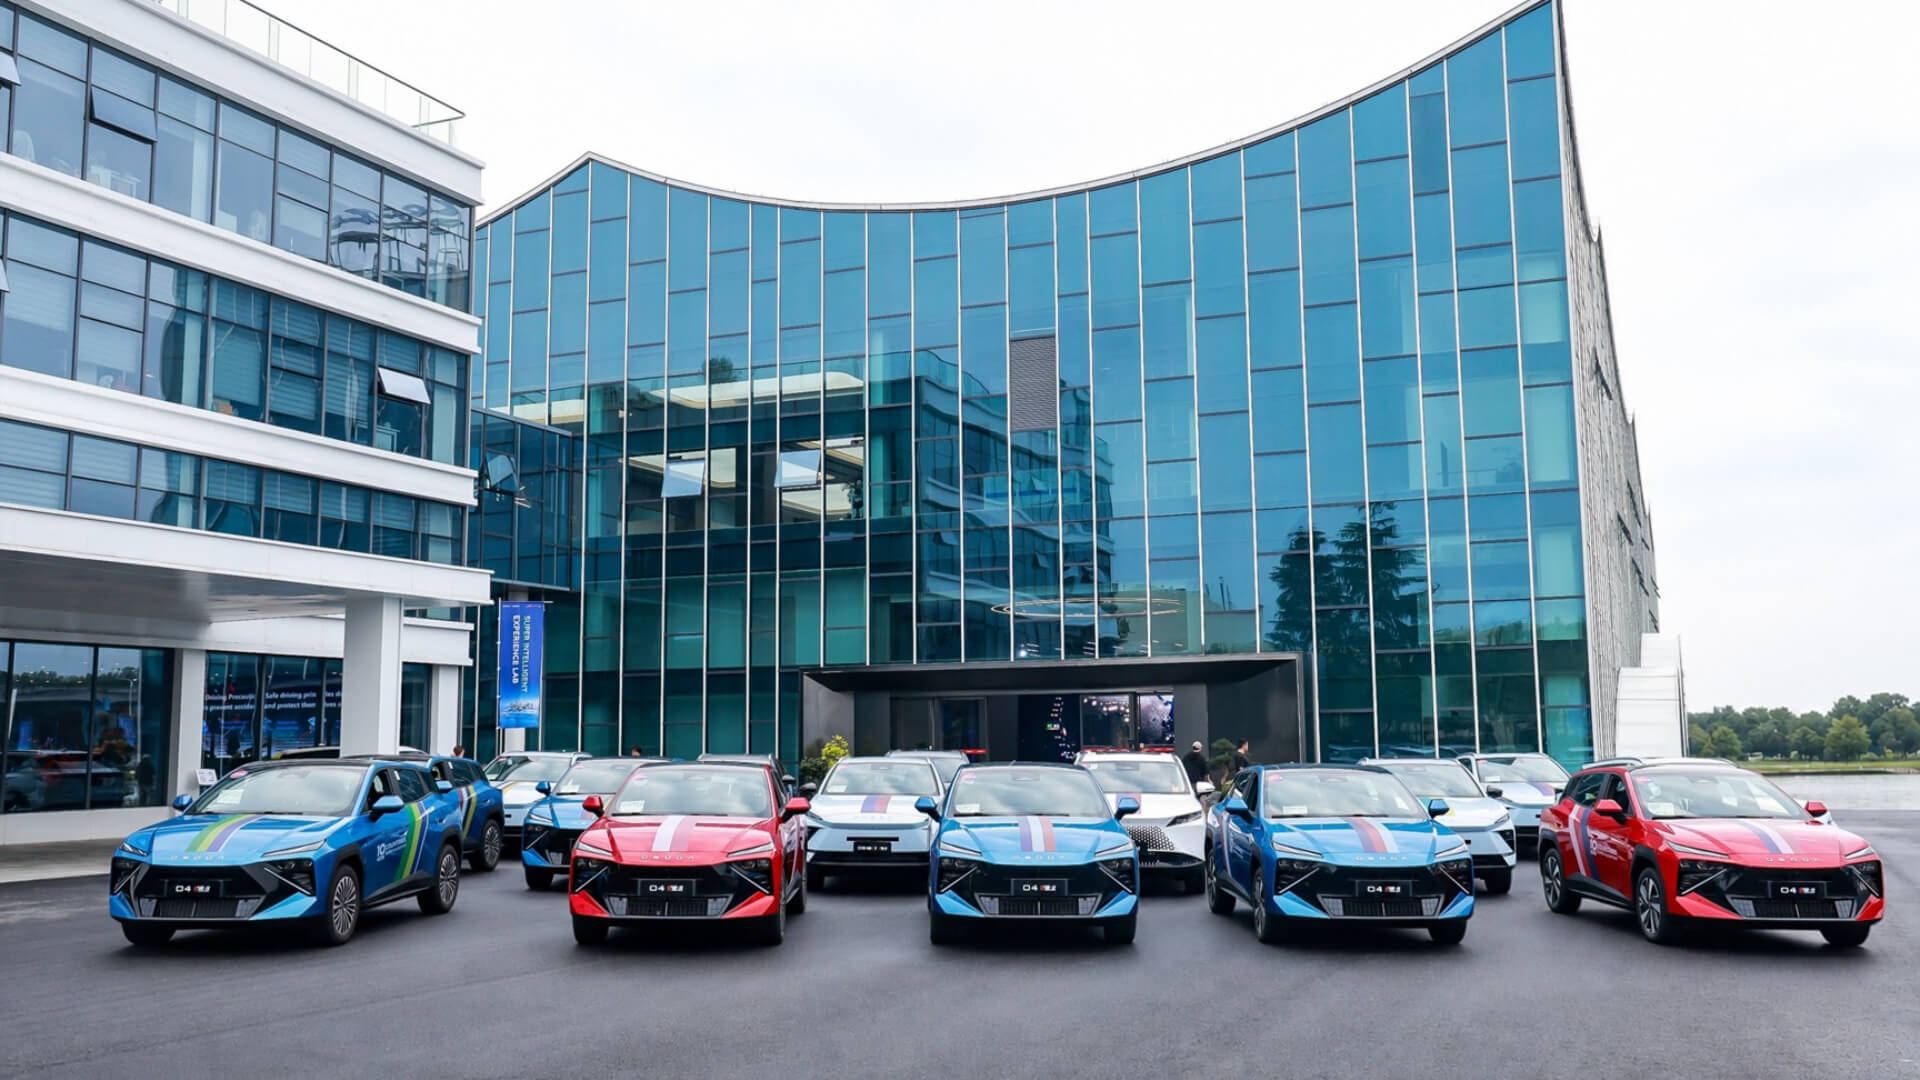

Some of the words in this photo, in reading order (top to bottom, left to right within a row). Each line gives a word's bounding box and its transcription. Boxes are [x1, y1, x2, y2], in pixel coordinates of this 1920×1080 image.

[523, 615, 531, 640] SUPER
[512, 615, 521, 665] EXPERIENCE
[512, 667, 520, 684] LAB
[520, 642, 530, 693] INTELLIGENT
[265, 691, 279, 699] Safe
[279, 691, 302, 700] driving
[277, 702, 300, 711] protect
